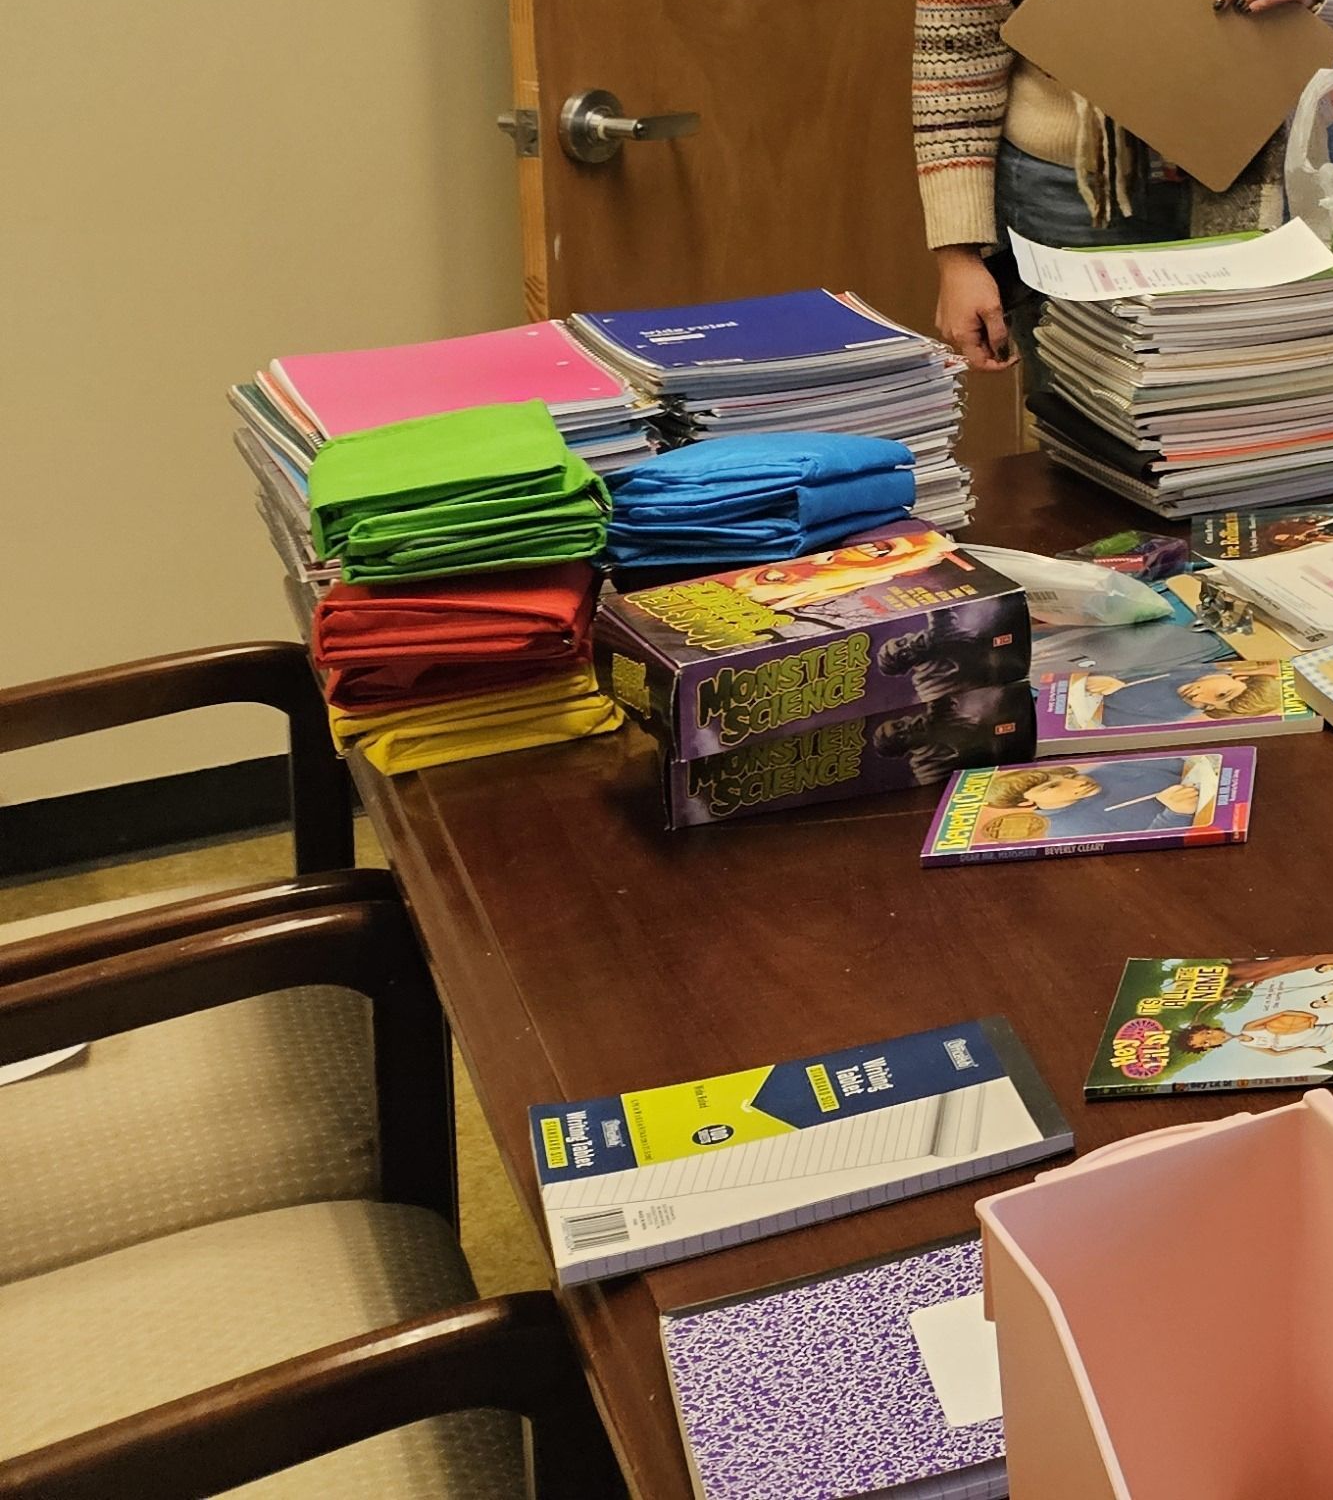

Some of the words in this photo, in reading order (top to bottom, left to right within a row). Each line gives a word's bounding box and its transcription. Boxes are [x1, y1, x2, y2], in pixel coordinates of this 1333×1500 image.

[697, 633, 872, 730] MONSTER
[719, 667, 866, 746] SCIENCE
[686, 717, 866, 798] MONSTER
[709, 749, 862, 817] SCIENCE
[1044, 845, 1076, 857] BEVERLY
[1077, 842, 1105, 854] CLEARY
[1162, 987, 1189, 1008] ALL
[1192, 968, 1224, 1001] NAME
[1110, 1038, 1141, 1068] Hey
[836, 1065, 865, 1097] Tablet
[863, 1056, 894, 1093] Writing
[566, 1110, 591, 1143] Writing
[571, 1139, 595, 1169] Tablet
